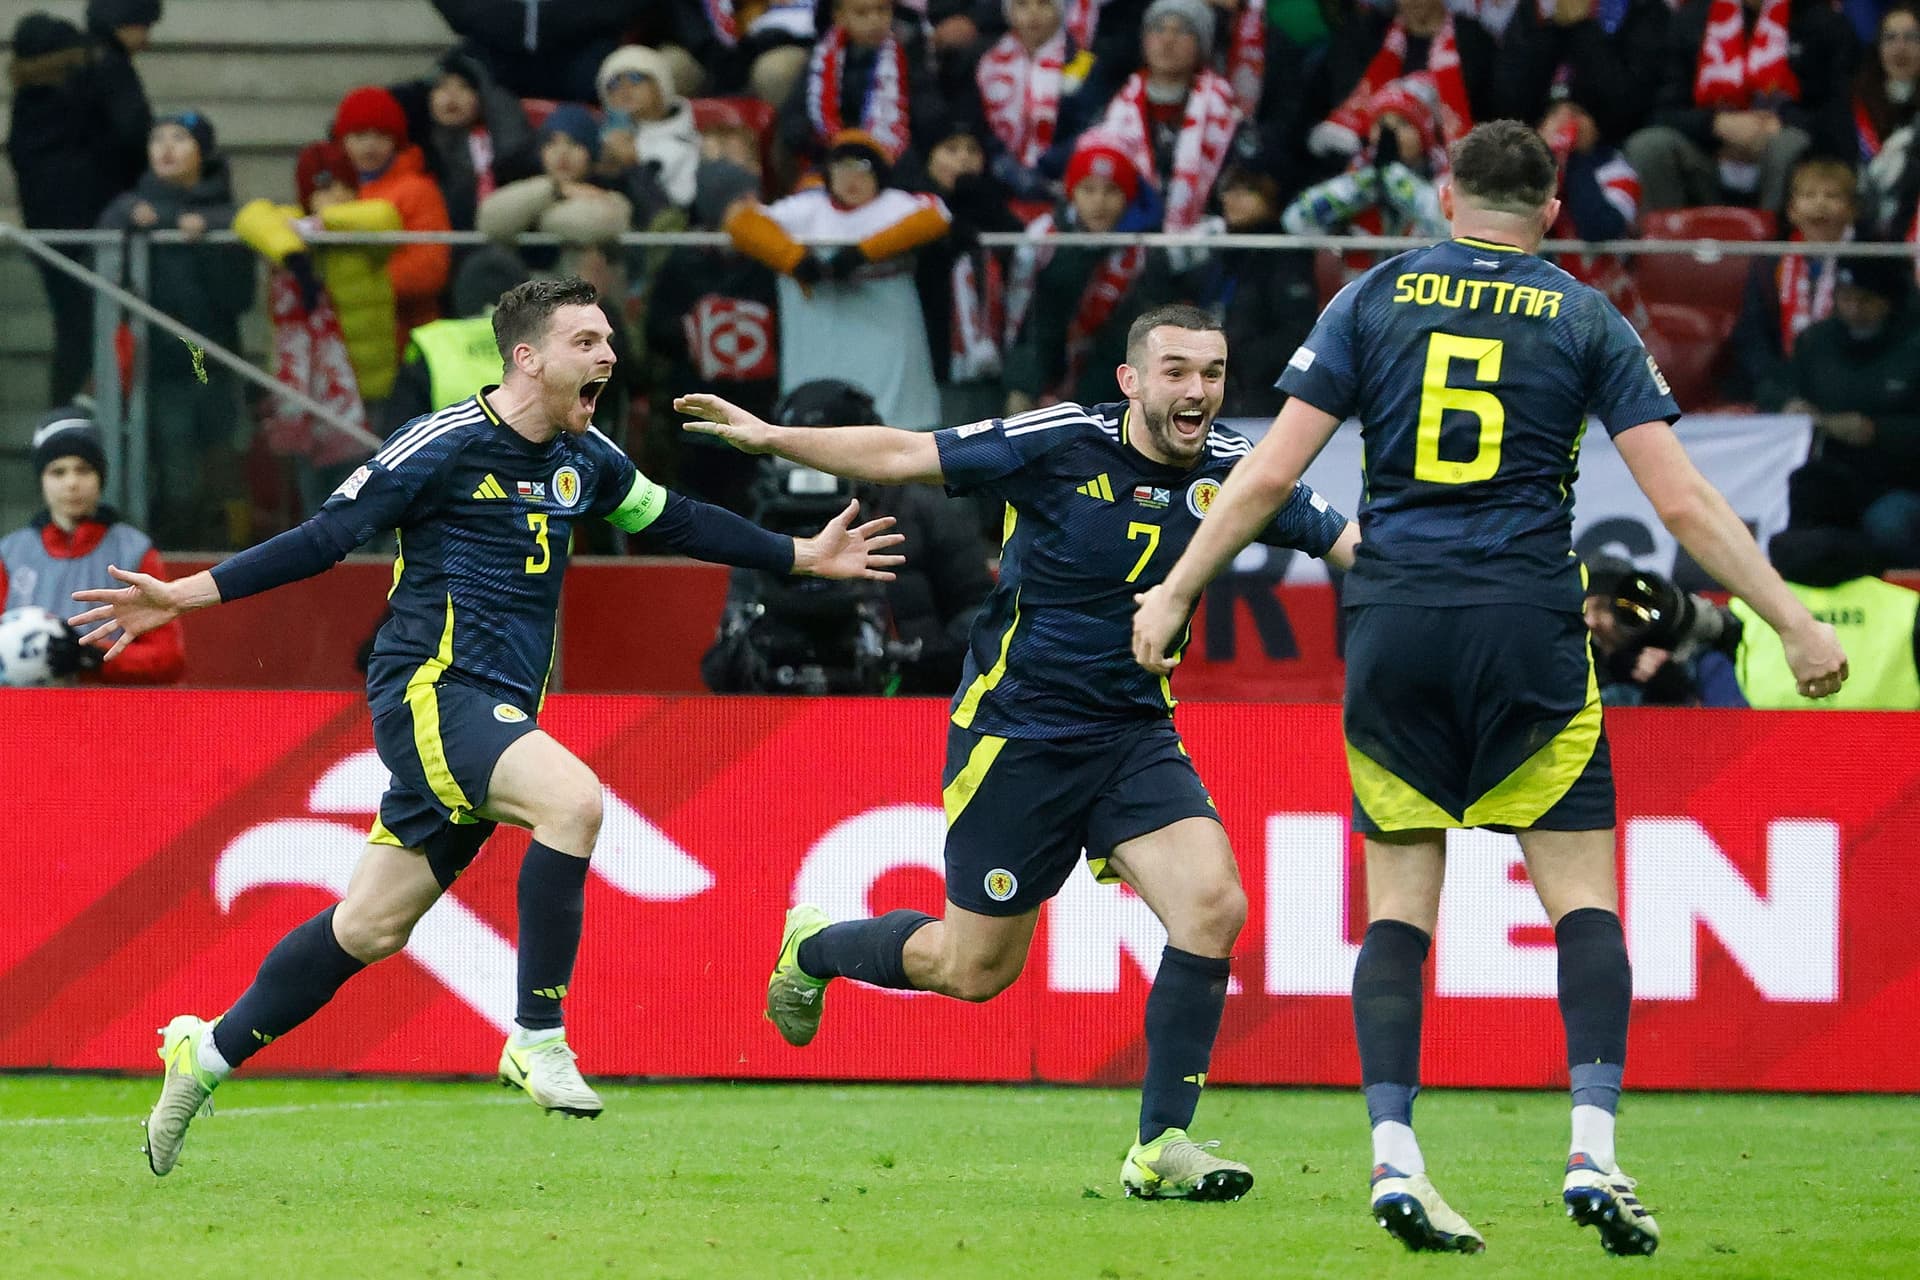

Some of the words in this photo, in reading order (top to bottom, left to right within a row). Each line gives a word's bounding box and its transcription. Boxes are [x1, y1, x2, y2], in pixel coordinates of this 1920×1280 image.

[1393, 272, 1564, 318] SOUTTAR
[1414, 332, 1505, 485] 6
[525, 513, 550, 574] 3
[1125, 521, 1161, 582] 7
